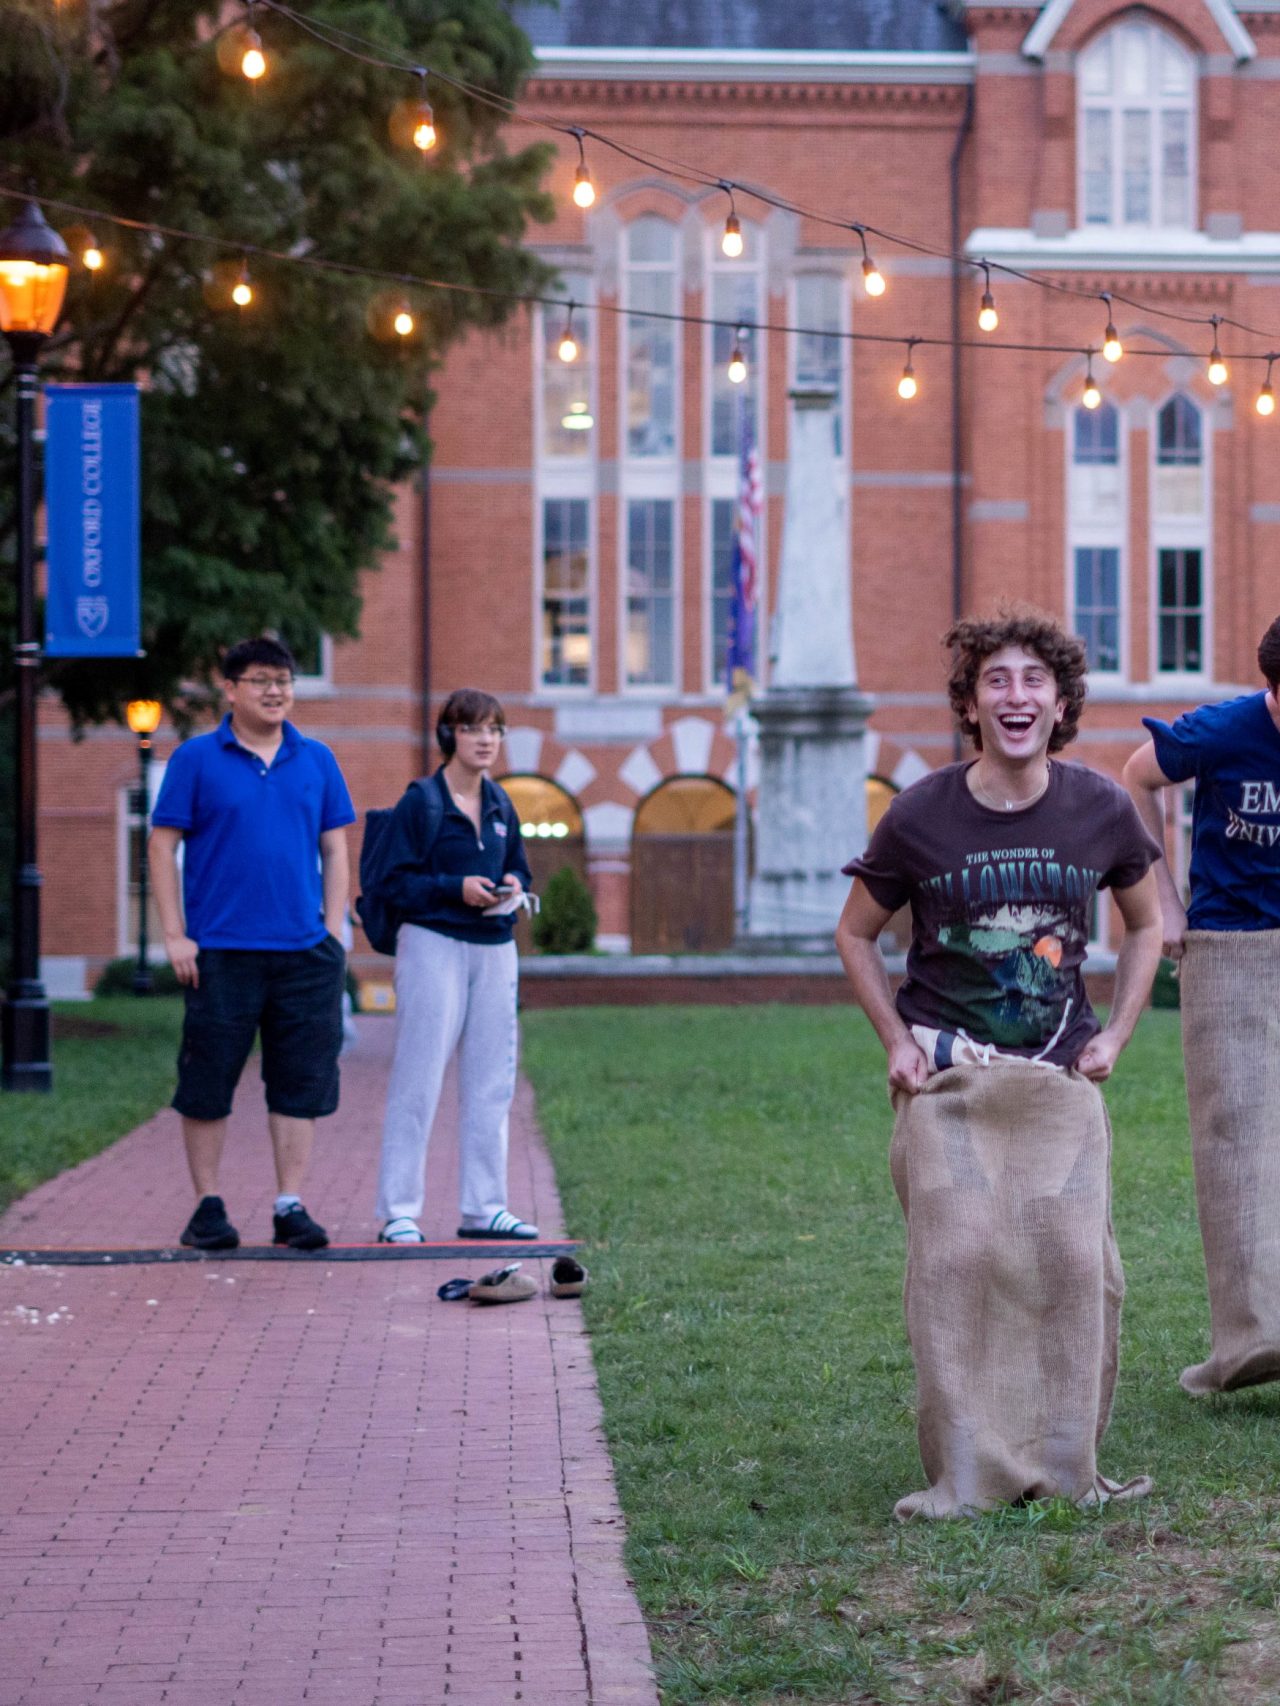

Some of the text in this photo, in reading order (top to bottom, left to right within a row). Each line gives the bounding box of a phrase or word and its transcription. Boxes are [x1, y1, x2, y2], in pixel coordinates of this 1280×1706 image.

[82, 400, 102, 587] OXFORD COLLEGE
[965, 848, 1055, 865] THE WONDER OF
